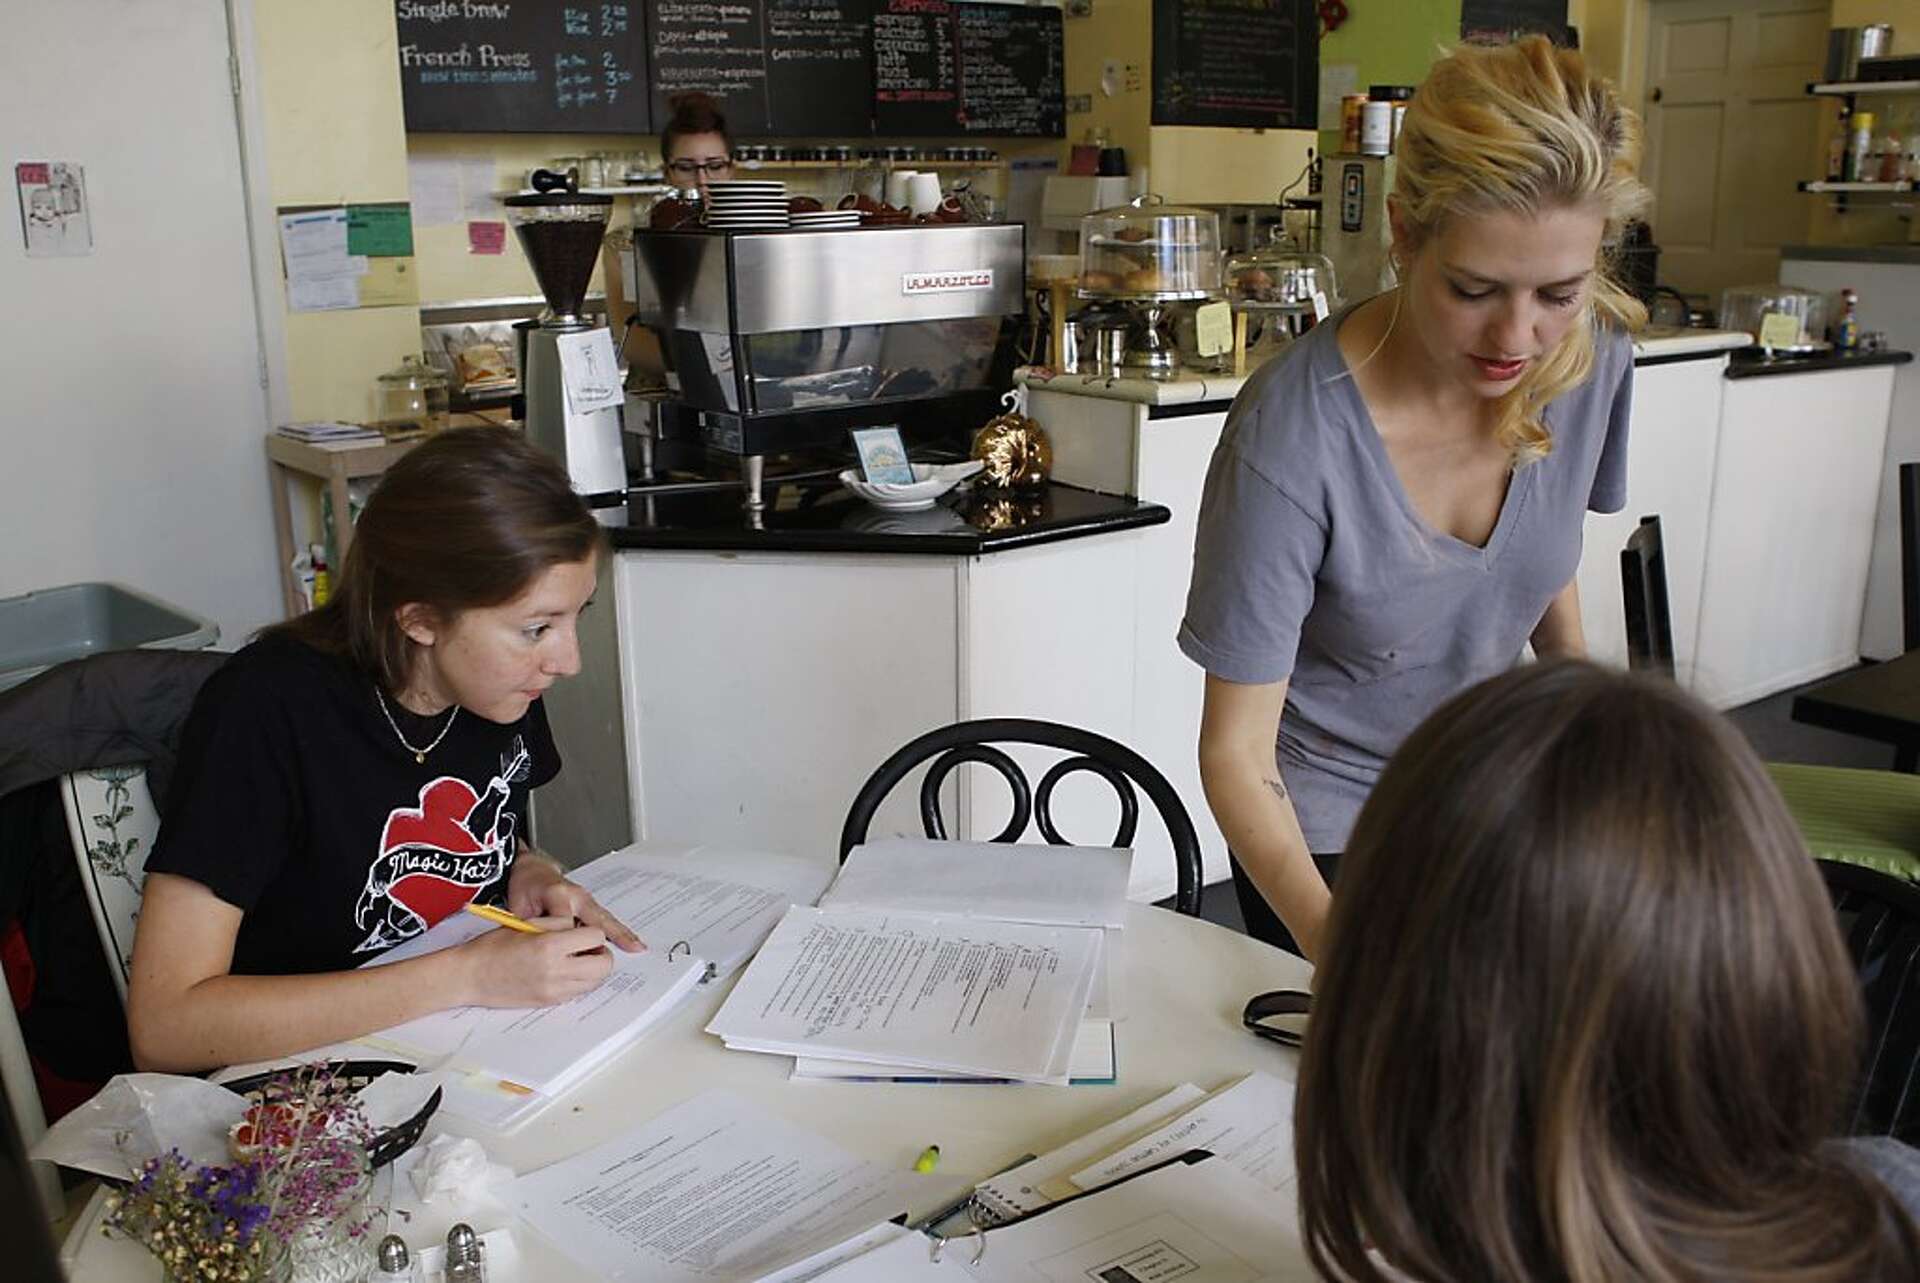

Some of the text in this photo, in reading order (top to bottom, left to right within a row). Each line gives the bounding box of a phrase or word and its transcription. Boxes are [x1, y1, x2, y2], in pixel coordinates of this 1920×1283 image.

[398, 0, 460, 22] Single
[401, 43, 531, 67] French Press
[389, 851, 496, 884] Magic Hat
